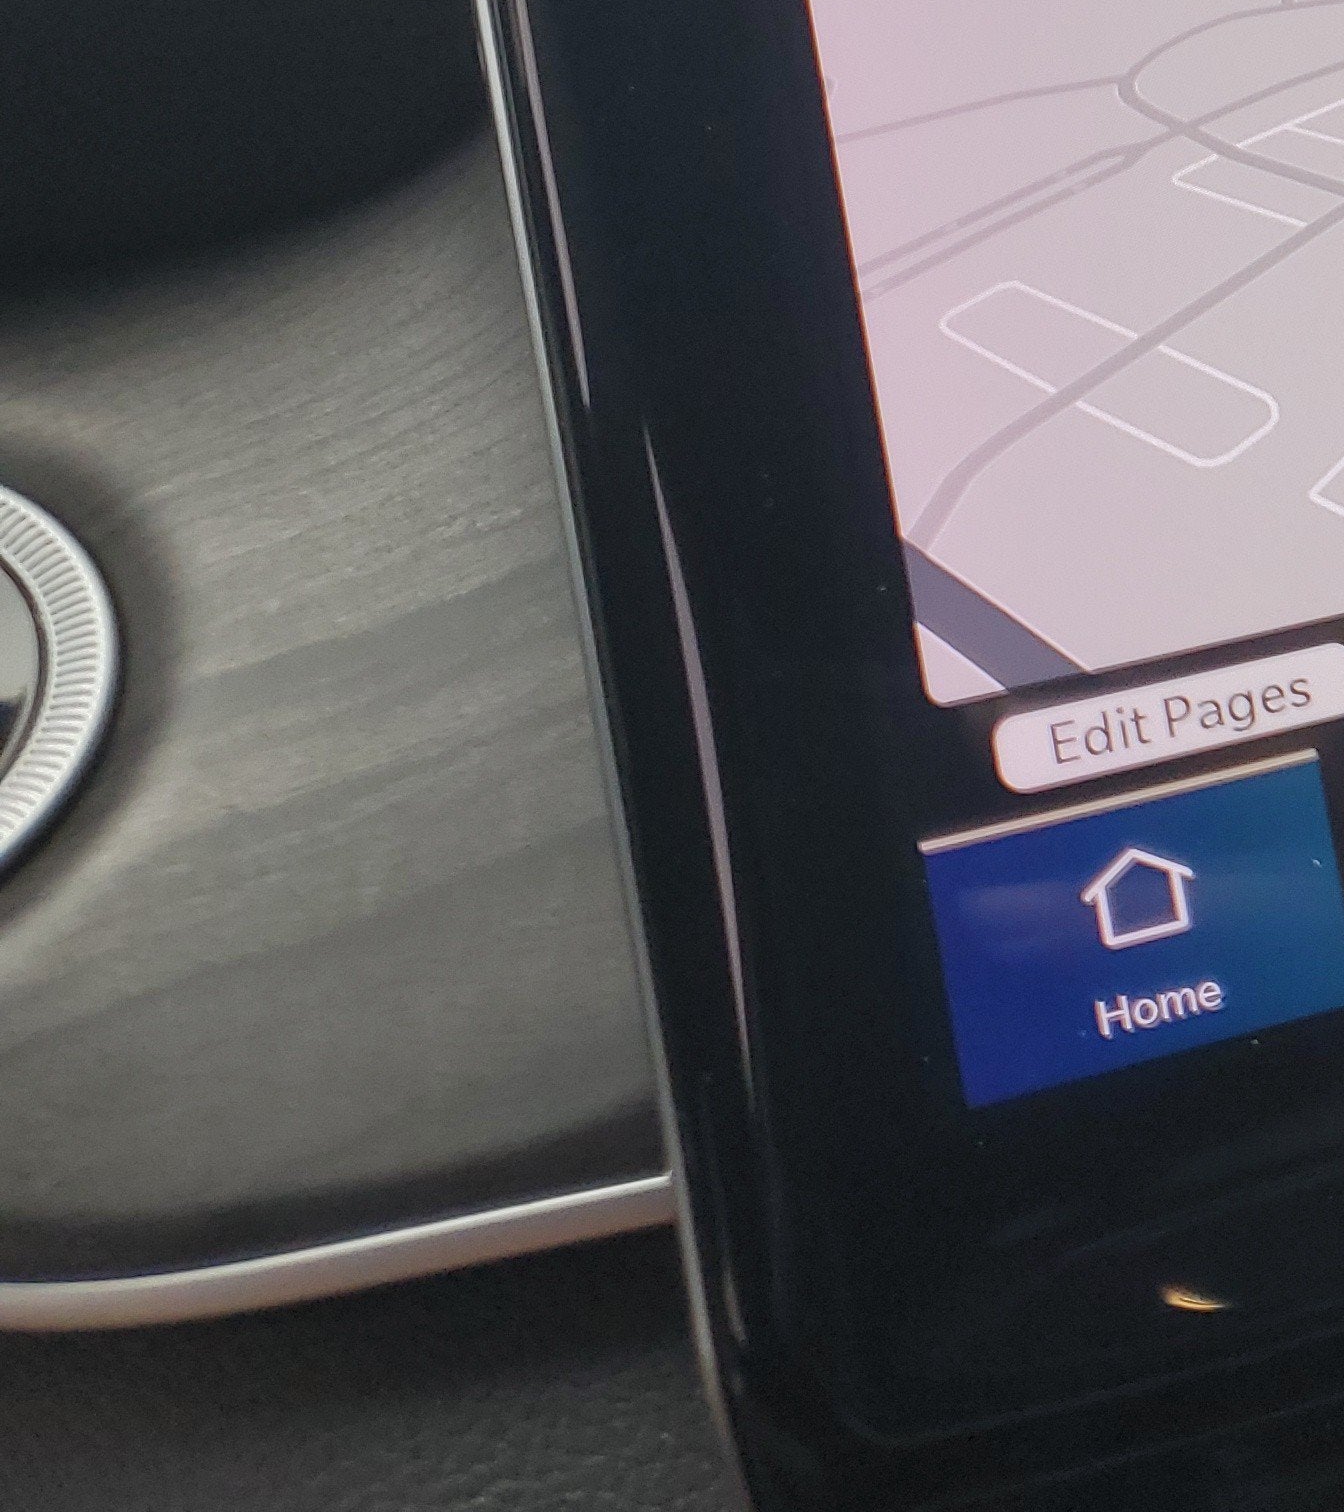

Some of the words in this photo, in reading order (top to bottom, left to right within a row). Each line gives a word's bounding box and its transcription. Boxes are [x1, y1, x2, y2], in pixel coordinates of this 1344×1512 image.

[1049, 707, 1151, 765] Edit
[1164, 675, 1311, 740] Pages
[1095, 979, 1225, 1038] Home
